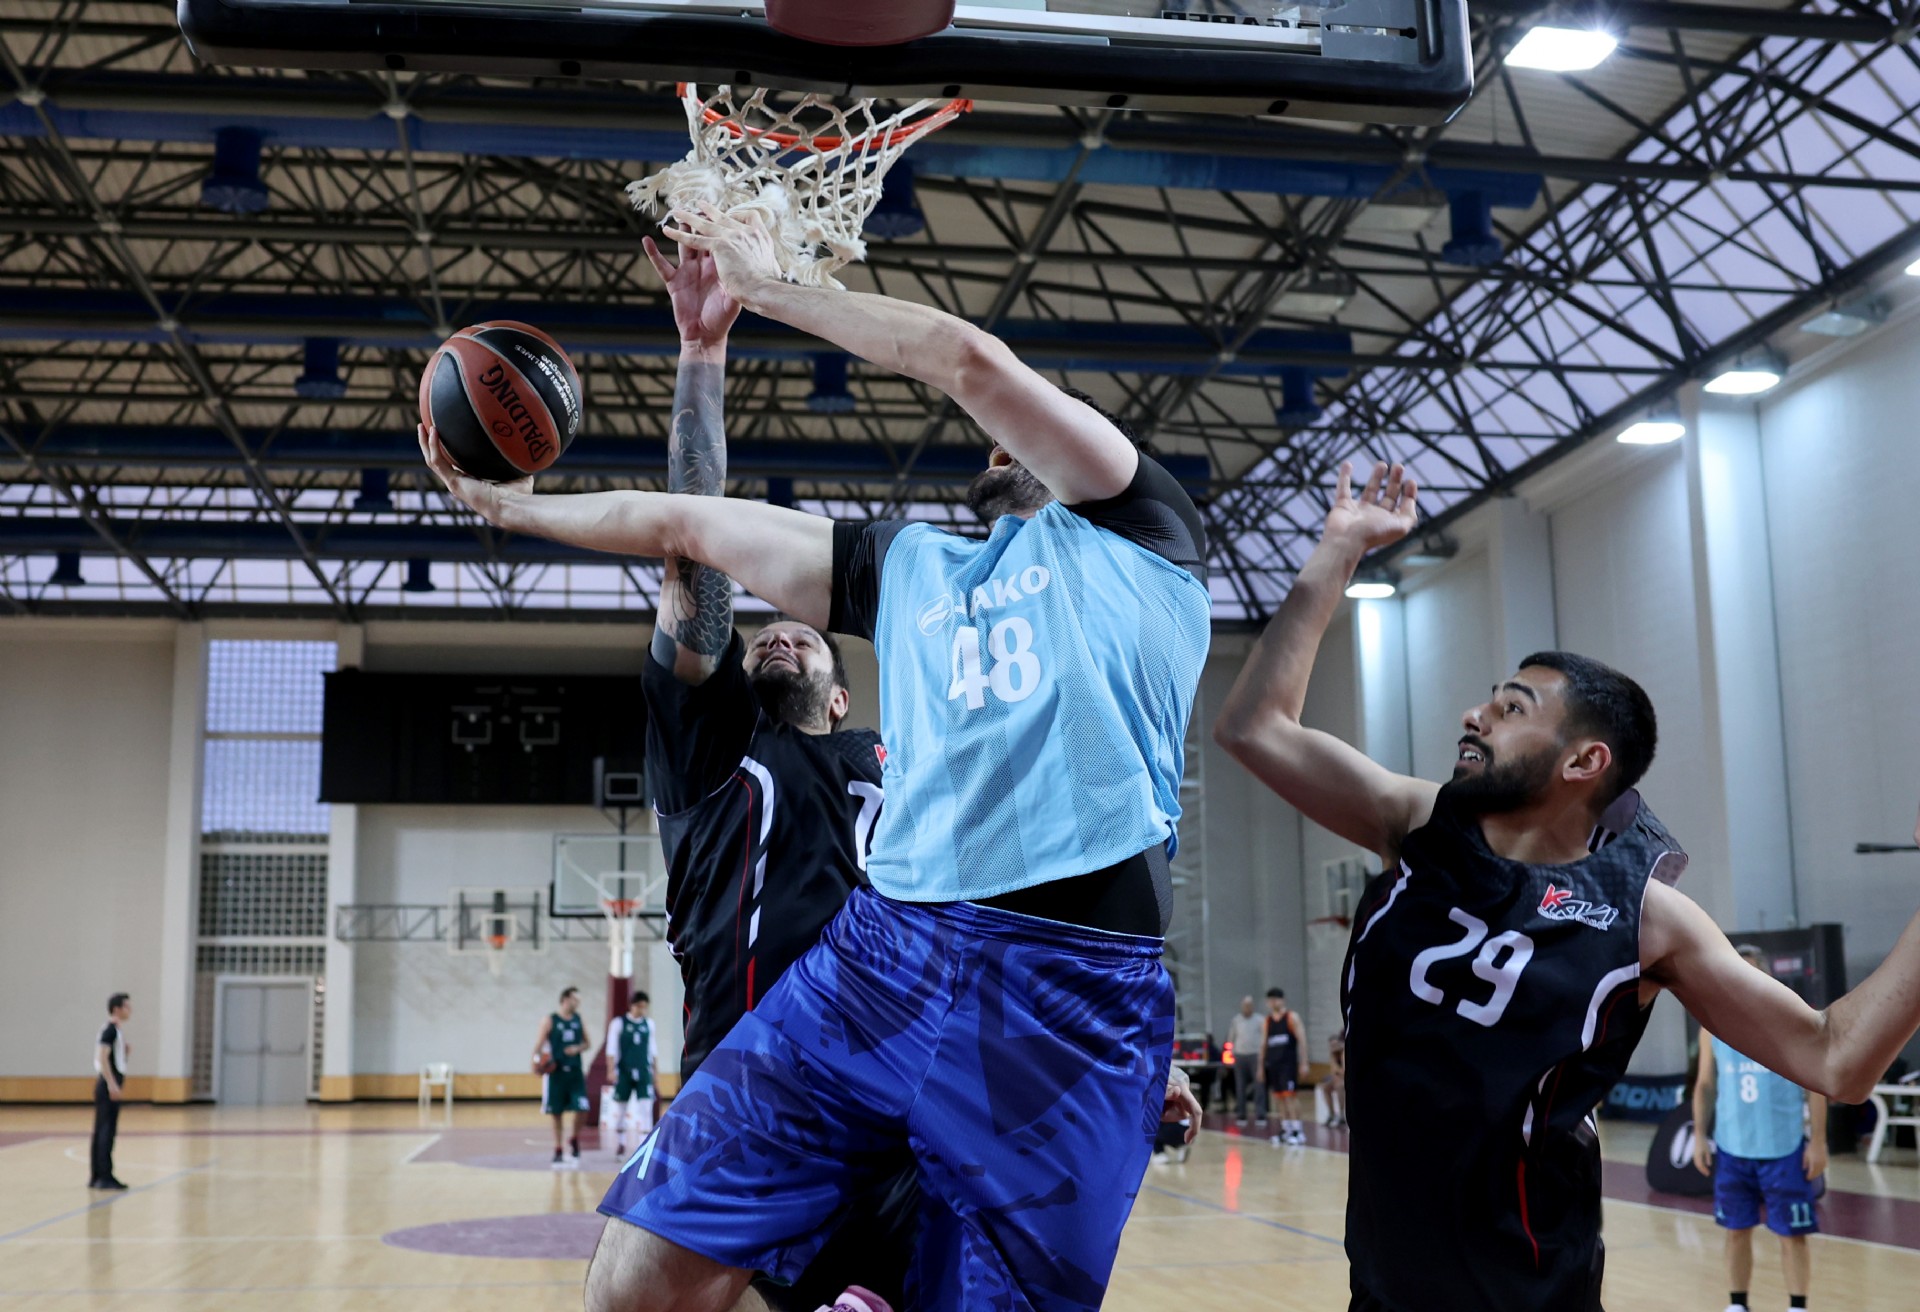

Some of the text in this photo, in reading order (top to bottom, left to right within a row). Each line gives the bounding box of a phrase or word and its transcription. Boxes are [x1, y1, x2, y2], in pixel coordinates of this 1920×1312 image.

[479, 363, 554, 463] SPALDING
[954, 565, 1050, 618] JAKO
[948, 616, 1041, 711] 48
[1409, 906, 1535, 1028] 29
[1740, 1073, 1759, 1103] 8
[1790, 1202, 1812, 1228] 11
